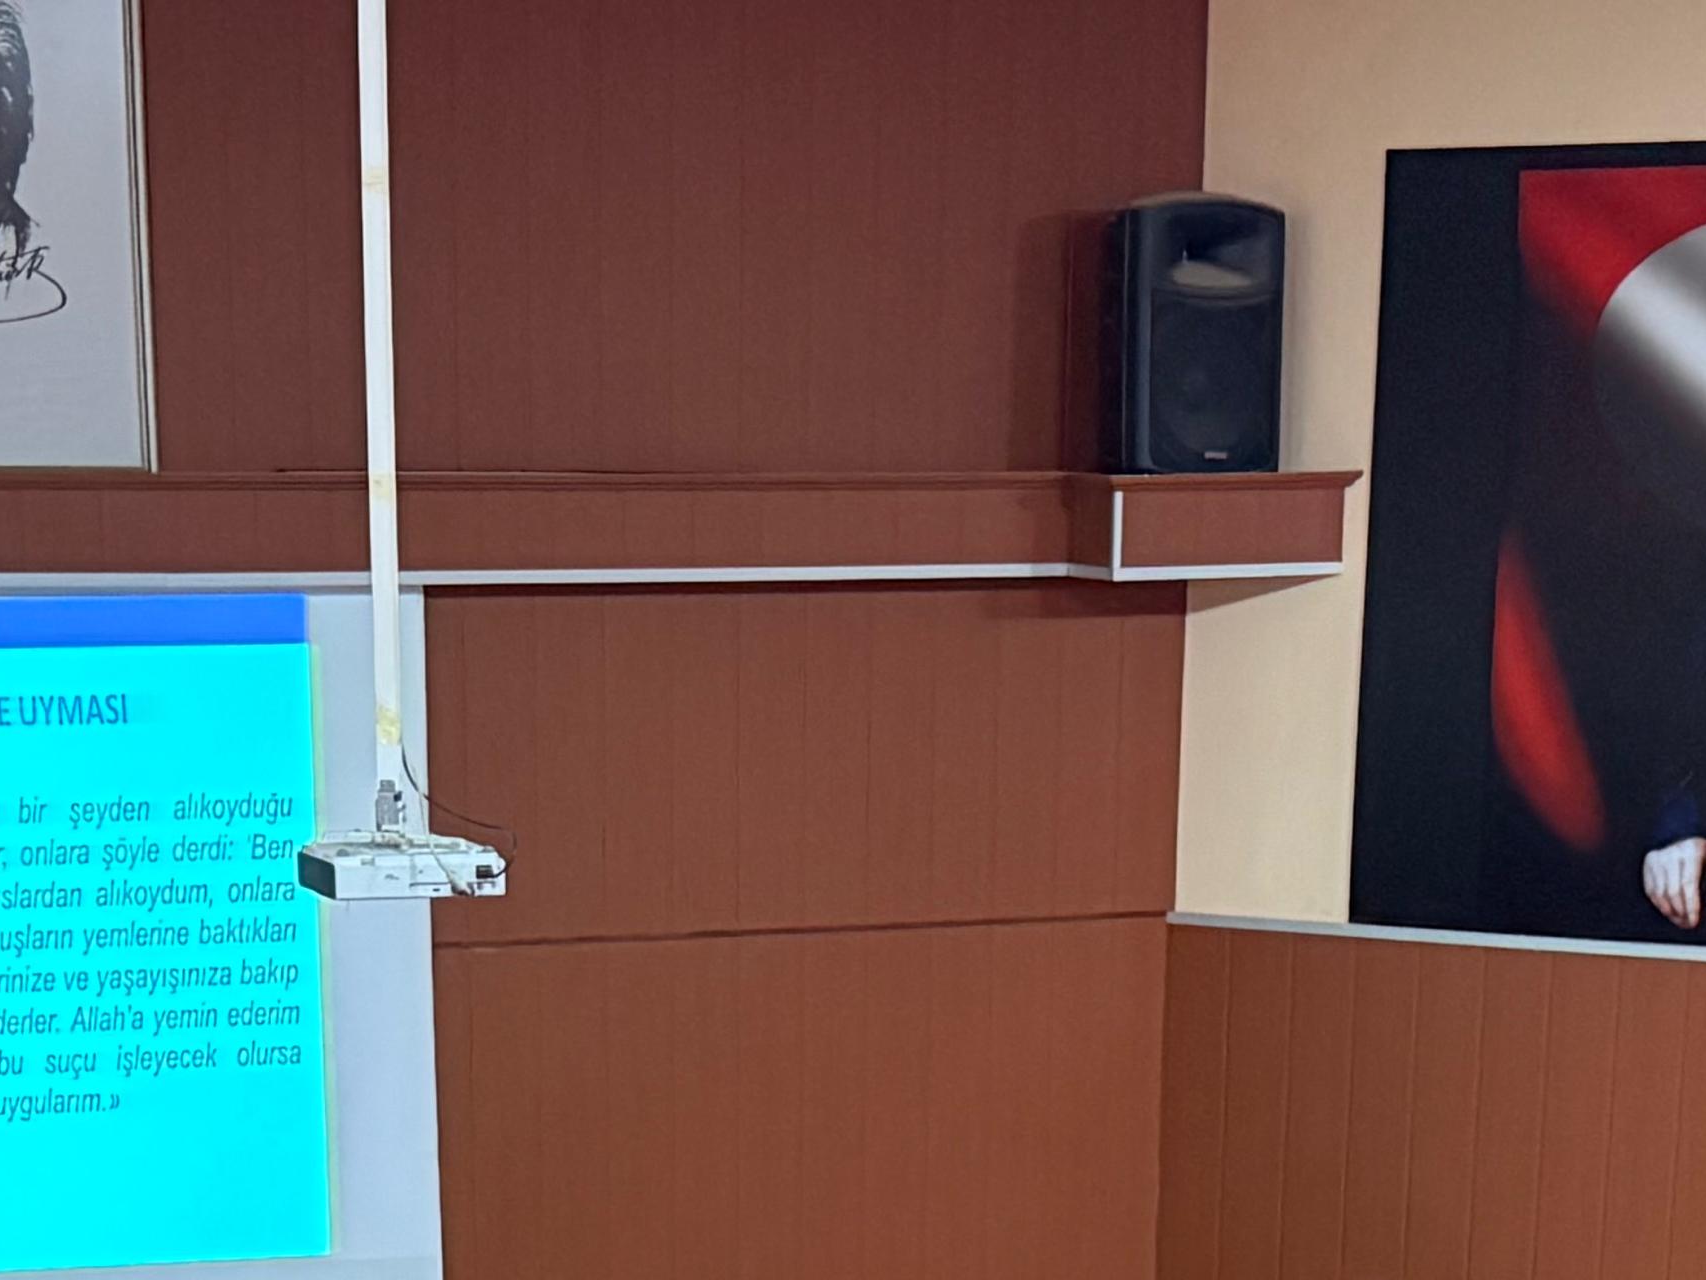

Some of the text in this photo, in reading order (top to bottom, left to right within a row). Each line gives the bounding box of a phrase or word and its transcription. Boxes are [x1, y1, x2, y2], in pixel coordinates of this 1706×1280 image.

[18, 693, 129, 726] UYMASI
[18, 797, 47, 824] bir
[69, 795, 150, 830] şeyden
[174, 792, 293, 827] alıkoyduğu
[20, 838, 90, 868] onlara
[102, 836, 160, 871] şöyle
[172, 834, 234, 862] derdi:
[95, 877, 213, 913] alıkoydum,
[227, 875, 295, 903] onlara
[83, 919, 190, 956] yemlerine
[199, 916, 297, 945] baktıkları
[63, 971, 89, 992] ve
[96, 966, 232, 997] yaşayışınıza
[240, 958, 299, 991] bakıp
[70, 1004, 144, 1033] Allah'a
[153, 1002, 218, 1037] yemin
[227, 999, 300, 1027] ederim
[44, 1052, 97, 1080] suçu
[116, 1041, 218, 1077] işleyecek
[237, 1040, 302, 1067] olursa
